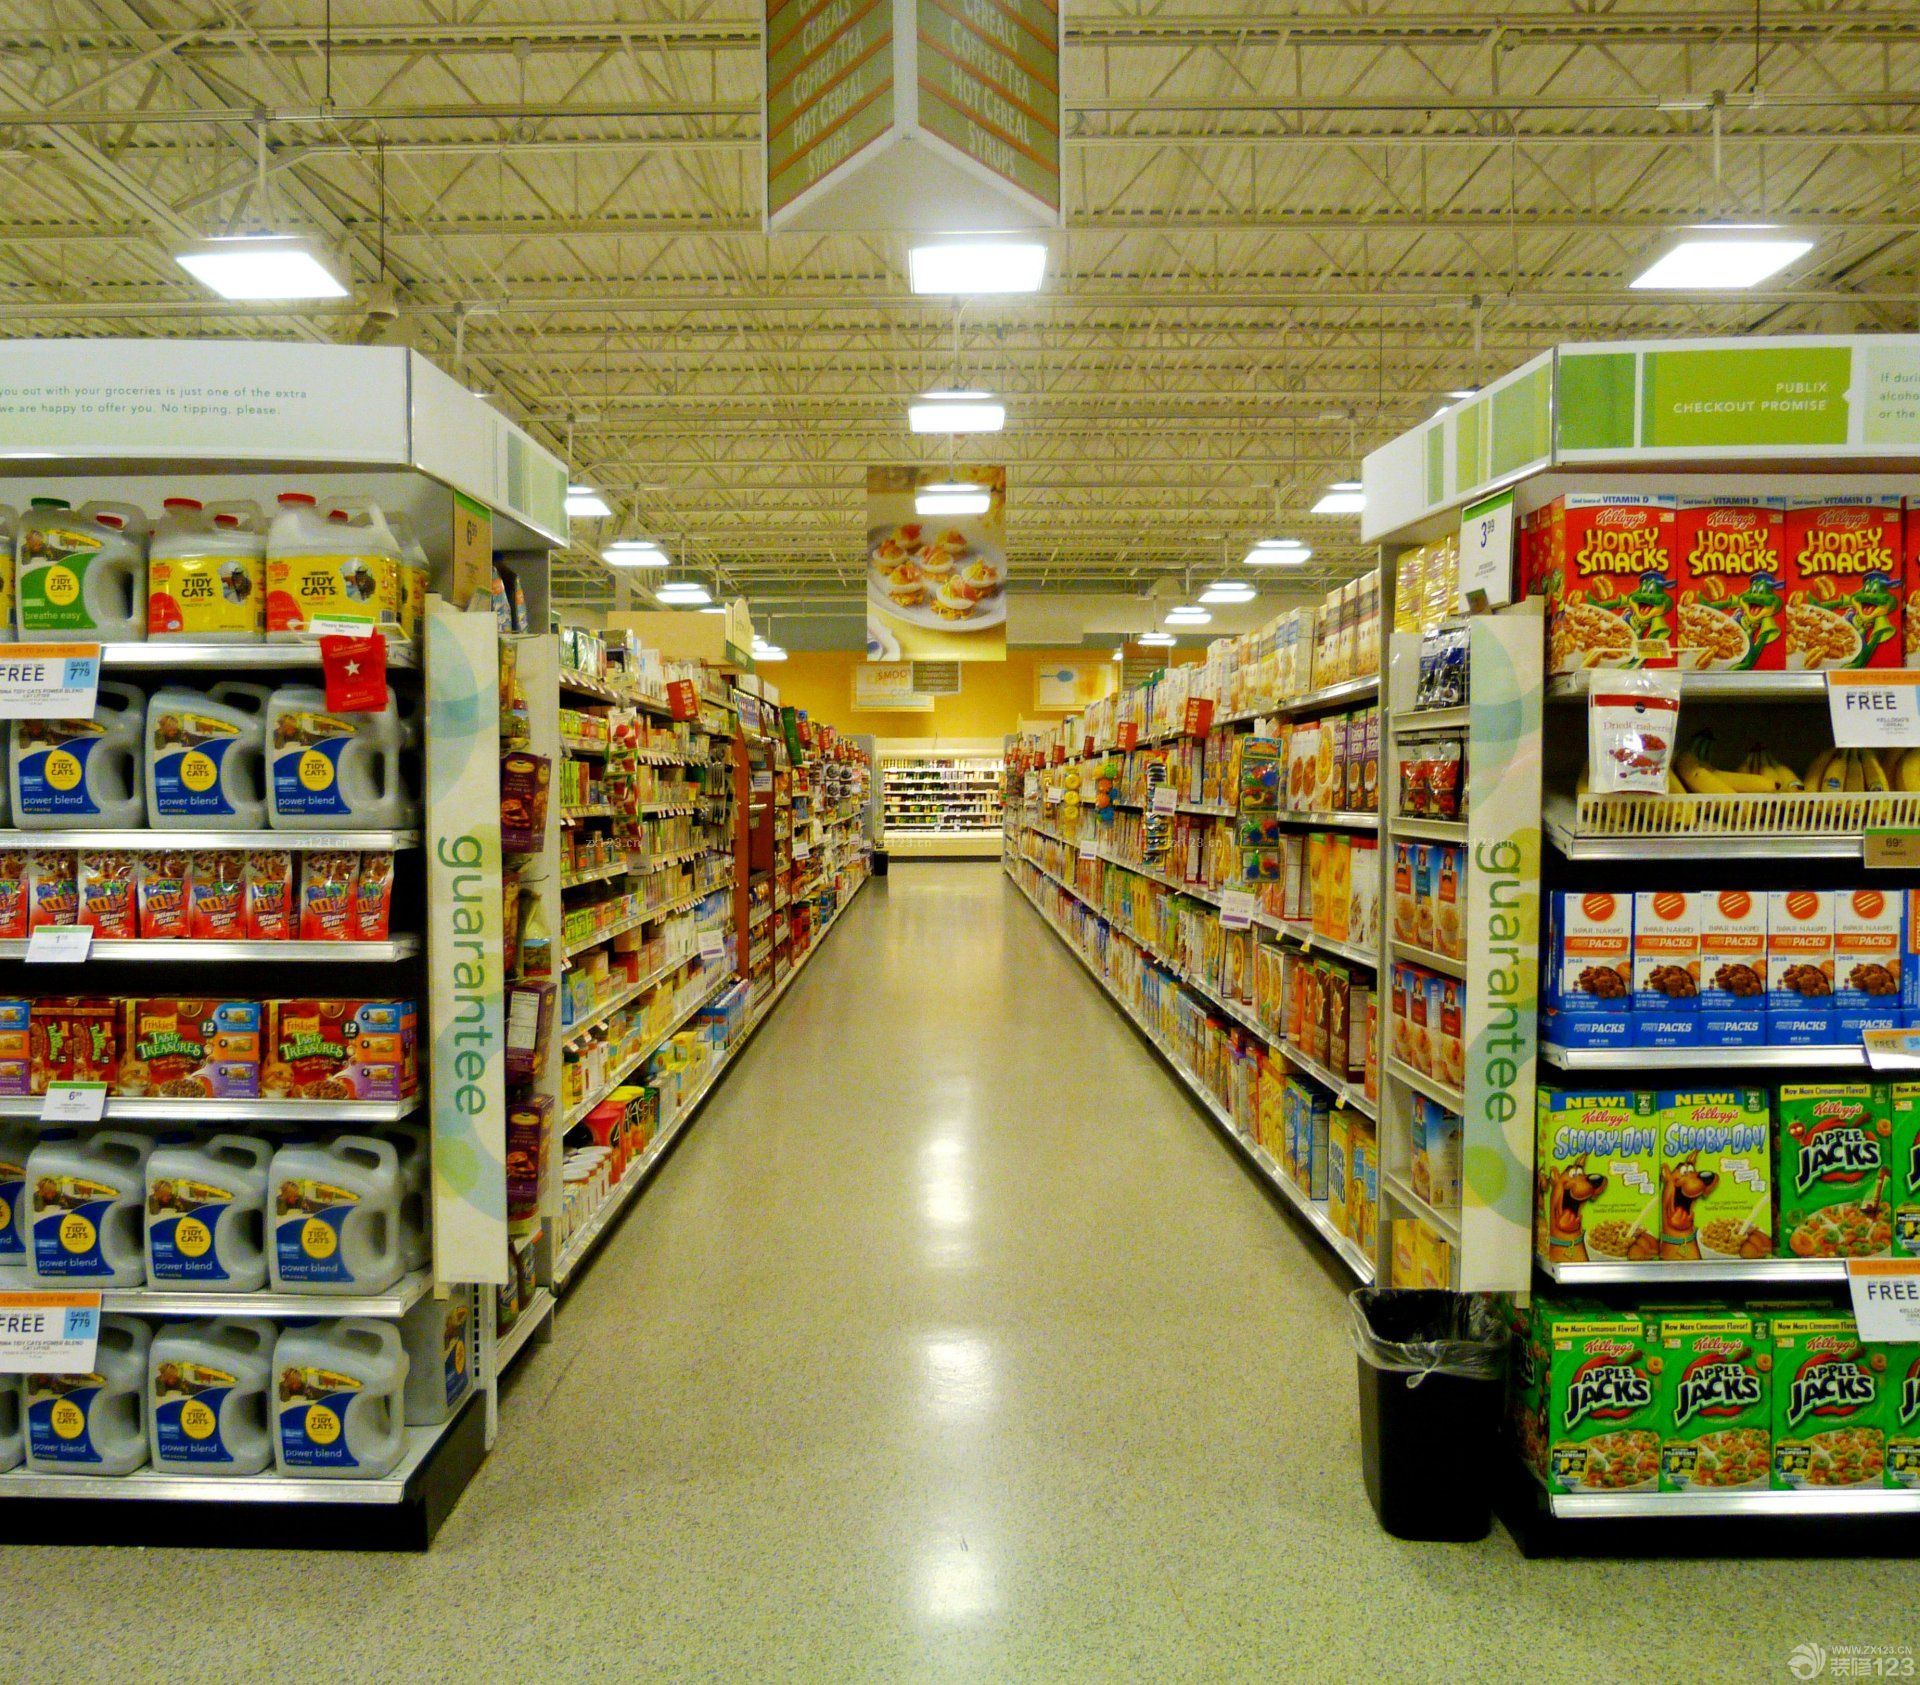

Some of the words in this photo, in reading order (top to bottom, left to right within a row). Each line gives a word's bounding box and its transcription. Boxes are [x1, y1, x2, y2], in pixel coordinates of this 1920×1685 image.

[22, 387, 41, 396] out
[46, 387, 70, 396] with
[75, 388, 100, 398] your
[105, 387, 161, 398] groceries
[166, 388, 175, 396] is
[180, 387, 202, 398] just
[207, 389, 229, 397] one
[234, 387, 247, 397] of
[251, 387, 271, 398] the
[275, 390, 307, 398] extra
[1776, 382, 1828, 393] PUBLIX
[0, 405, 15, 413] we
[19, 405, 37, 413] are
[42, 404, 76, 415] happy
[82, 404, 93, 413] to
[98, 402, 126, 413] offer
[162, 403, 179, 413] No
[1673, 401, 1755, 413] CHECKOUT
[1761, 400, 1827, 412] PROMISE
[1879, 411, 1890, 419] or
[1896, 410, 1915, 419] the
[1603, 495, 1640, 504] VITAMIN
[1643, 495, 1648, 504] D
[1714, 496, 1751, 505] VITAMIN
[1752, 496, 1758, 505] D
[1824, 496, 1864, 504] VITAMIN
[1866, 496, 1872, 504] D
[1596, 508, 1647, 528] Kellogg's
[1707, 509, 1757, 529] Kellogg's
[1817, 510, 1870, 529] Kellogg's
[1585, 527, 1659, 553] HONEY
[1696, 528, 1768, 554] HONEY
[1806, 527, 1883, 554] HONEY
[1576, 548, 1670, 575] SMACKS
[1688, 549, 1779, 575] SMACKS
[1798, 548, 1893, 576] SMACKS
[182, 578, 213, 588] TIDY
[302, 576, 334, 587] TIDY
[181, 588, 214, 598] CATS
[300, 586, 336, 596] CATS
[25, 611, 58, 620] breathe
[60, 613, 81, 621] easy
[1846, 695, 1897, 710] FREE
[24, 797, 52, 806] power
[54, 795, 83, 804] blend
[160, 798, 188, 806] power
[190, 796, 218, 805] blend
[279, 798, 306, 806] power
[308, 796, 336, 804] blend
[1588, 939, 1622, 948] PACKS
[1659, 938, 1692, 948] PACKS
[1724, 936, 1758, 946] PACKS
[1858, 936, 1892, 946] PACKS
[438, 835, 493, 1115] guarantee
[1475, 841, 1526, 1123] guarantee
[144, 1020, 176, 1030] Friskies
[202, 1022, 214, 1032] 12
[286, 1020, 318, 1032] Friskies
[344, 1023, 357, 1032] 12
[1591, 1023, 1625, 1033] PACKS
[1724, 1021, 1758, 1031] PACKS
[1565, 1096, 1626, 1110] NEW!
[1675, 1093, 1735, 1106] NEW!
[1691, 1106, 1739, 1123] Kellogg's
[1813, 1100, 1864, 1120] Kellogg's
[1582, 1109, 1630, 1127] Kellogg's
[1553, 1124, 1657, 1160] SCOOBY-DOO!
[1664, 1122, 1767, 1156] SCOOBY-DOO!
[1811, 1130, 1862, 1148] APPLE
[1798, 1143, 1881, 1189] JACKS
[65, 1232, 88, 1240] CATS
[38, 1260, 67, 1268] power
[70, 1258, 98, 1267] blend
[156, 1262, 182, 1270] power
[185, 1260, 212, 1270] blend
[1868, 1284, 1919, 1300] FREE
[70, 1318, 90, 1332] 779
[1584, 1337, 1635, 1357] Kellogg's
[1694, 1335, 1744, 1355] Kellogg's
[1806, 1335, 1857, 1354] Kellogg's
[1582, 1368, 1633, 1384] APPLE
[1691, 1366, 1742, 1382] APPLE
[1804, 1365, 1856, 1381] APPLE
[1566, 1380, 1649, 1423] JACKS
[1676, 1378, 1758, 1421] JACKS
[1789, 1378, 1874, 1421] JACKS
[286, 1450, 313, 1458] power
[316, 1448, 342, 1457] blend
